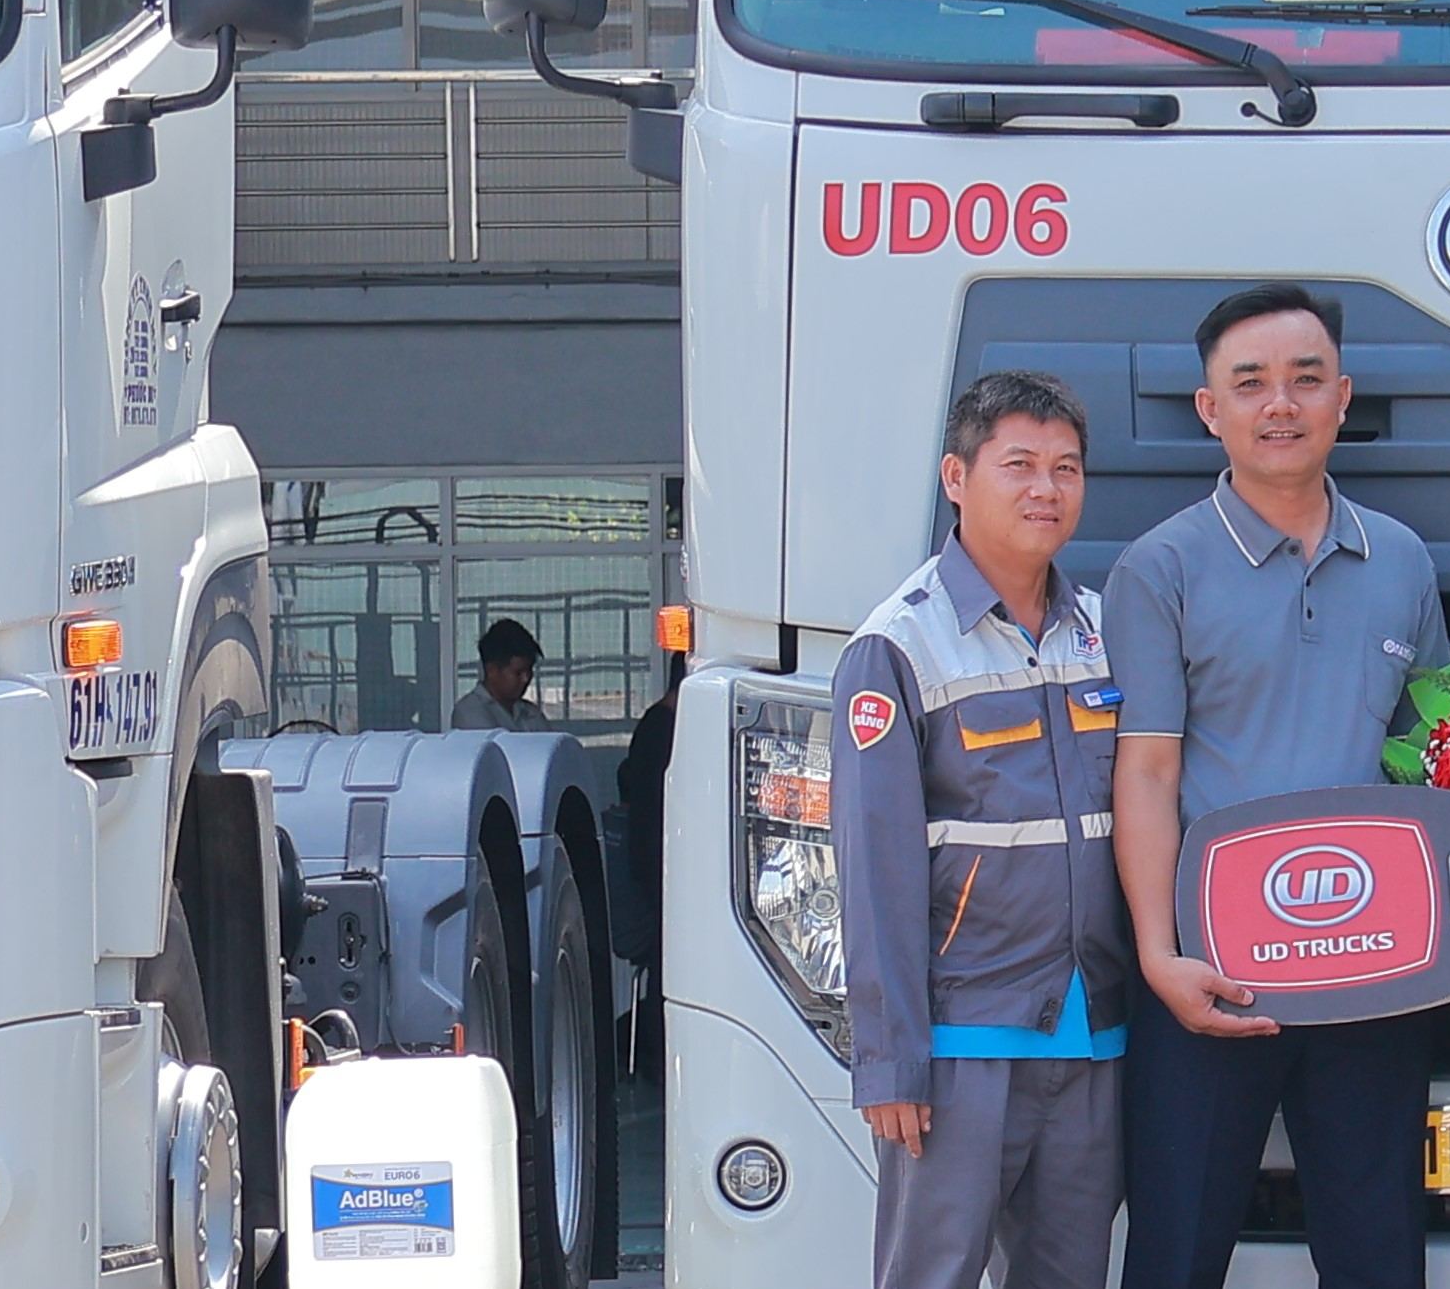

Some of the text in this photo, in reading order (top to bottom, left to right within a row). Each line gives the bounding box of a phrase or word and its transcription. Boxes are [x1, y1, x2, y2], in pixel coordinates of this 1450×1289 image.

[822, 182, 1069, 257] UD06
[1275, 866, 1363, 906] UD
[1252, 931, 1395, 962] UD TRUCKS
